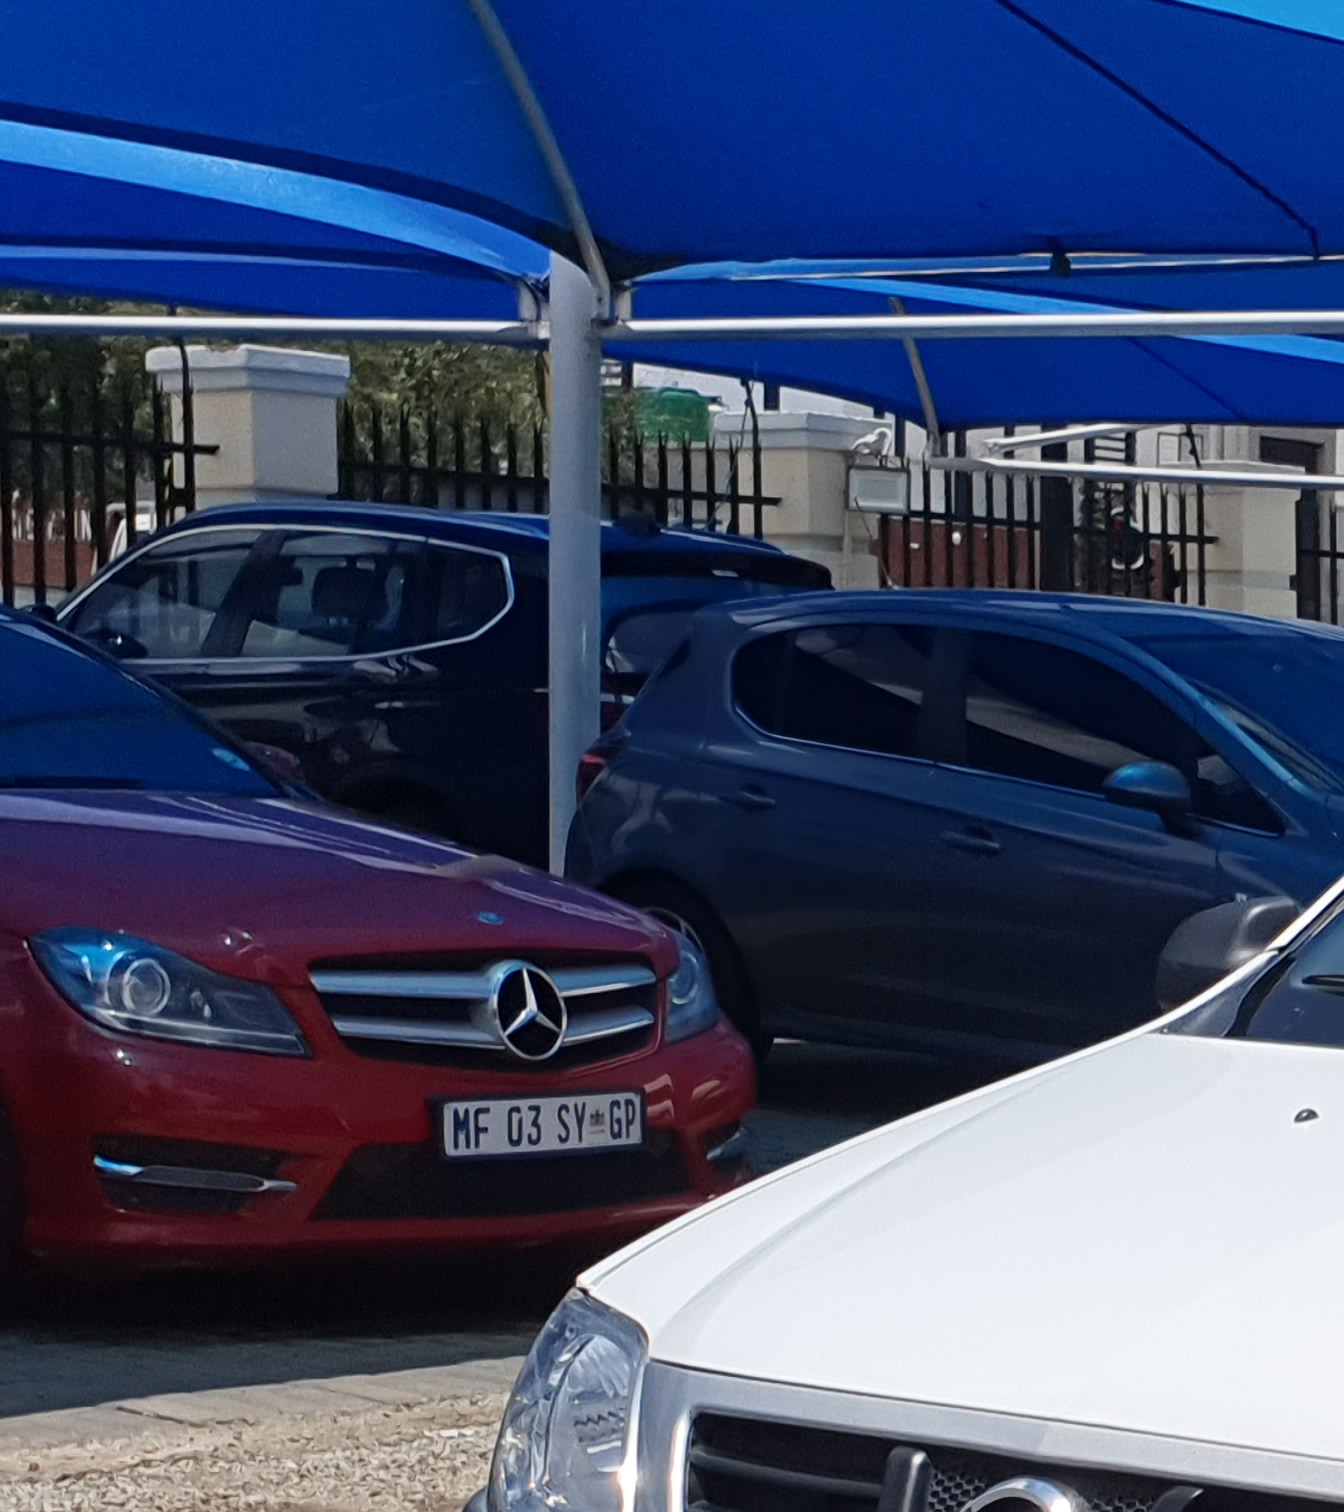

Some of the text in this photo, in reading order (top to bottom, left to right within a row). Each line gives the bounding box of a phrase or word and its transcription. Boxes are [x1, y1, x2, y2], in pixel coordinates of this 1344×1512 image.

[453, 1099, 636, 1150] MF 03 SY GP
